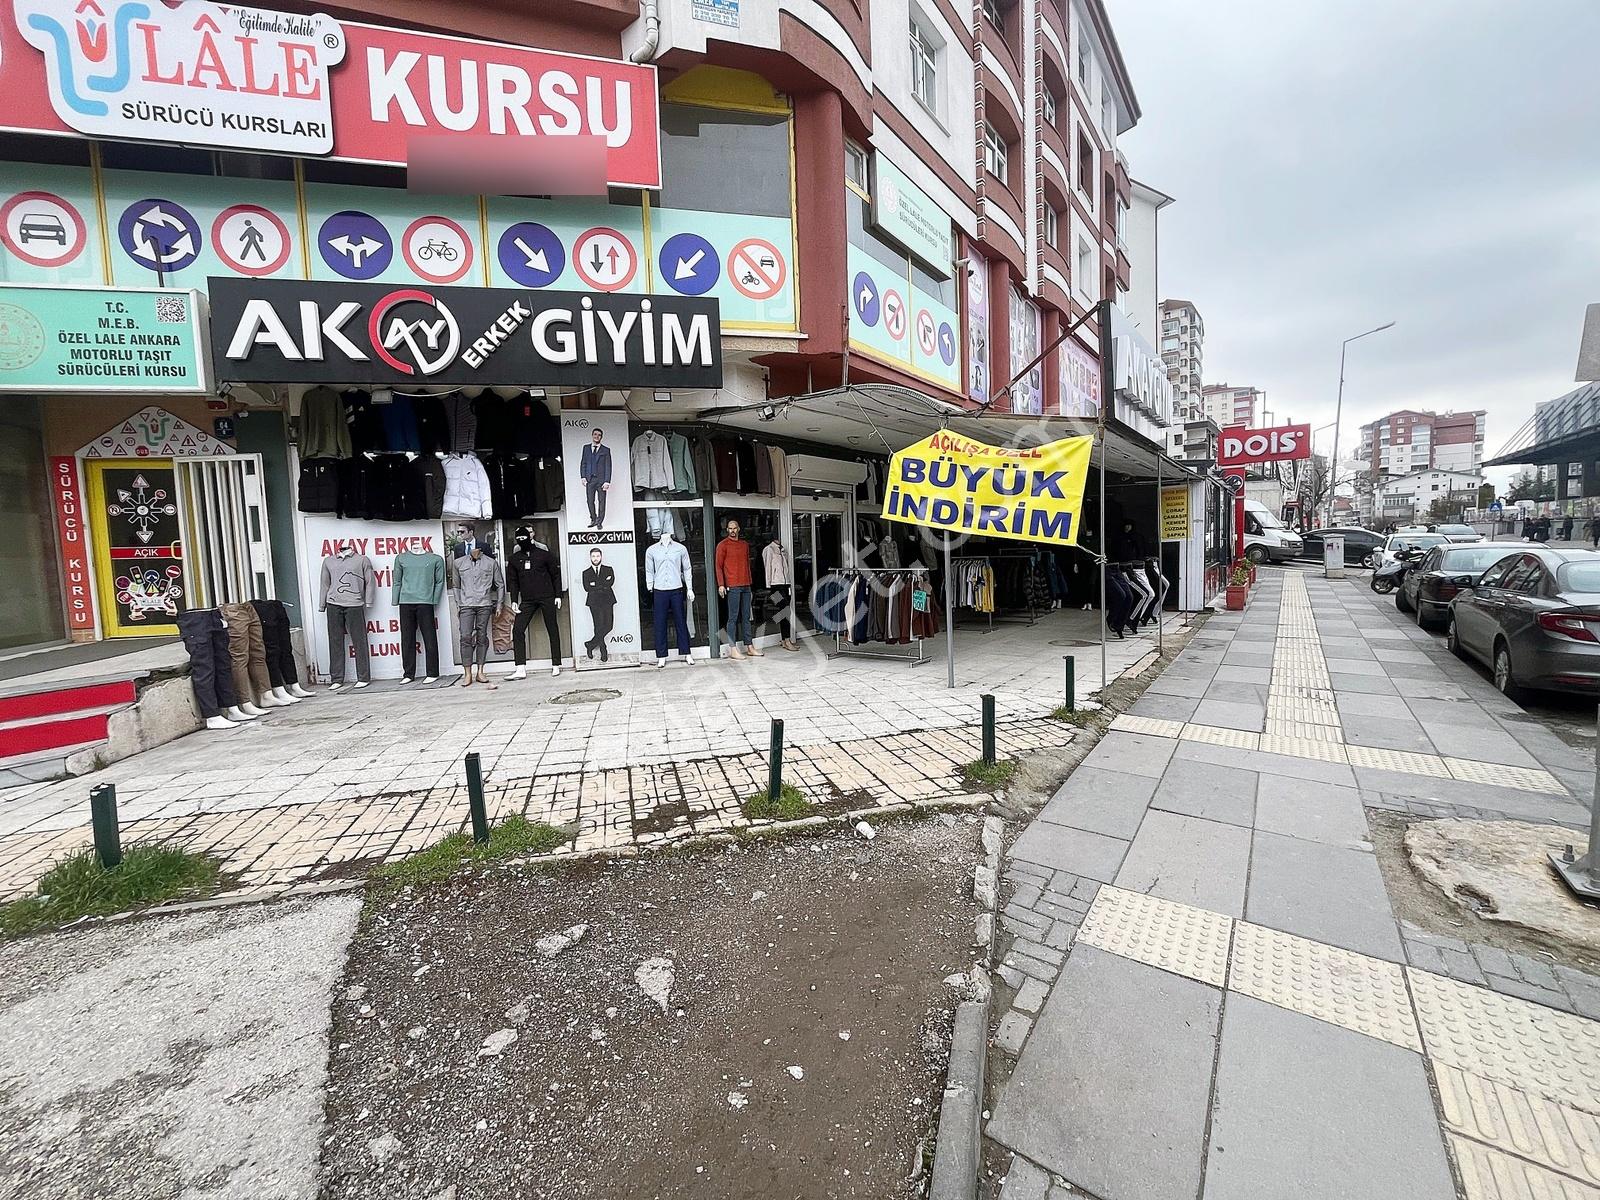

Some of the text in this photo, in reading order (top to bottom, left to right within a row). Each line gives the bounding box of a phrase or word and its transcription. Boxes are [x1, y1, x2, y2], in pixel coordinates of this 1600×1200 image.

[366, 46, 633, 148] KURSU
[121, 101, 327, 139] SÜRÜCÜ KURSLARI
[105, 301, 129, 314] T.C.
[98, 317, 139, 330] M.E.B.
[460, 299, 534, 370] ERKEK
[530, 295, 714, 367] GİYİM
[58, 330, 181, 346] ÖZEL LALE ANKARA
[70, 349, 172, 364] MOTORLU TAŞIT
[58, 362, 187, 377] SÜRÜCÜLERİ KURSU
[928, 433, 990, 458] AÇILIŞA
[900, 455, 1070, 500] BÜYÜK
[887, 485, 1073, 540] İNDİRİM
[58, 463, 87, 623] SÜRÜCÜ KURSU
[606, 531, 633, 542] GİYİM
[134, 548, 159, 558] AÇIK
[320, 536, 434, 557] AKAY ERKEK
[349, 641, 422, 658] BLUNR
